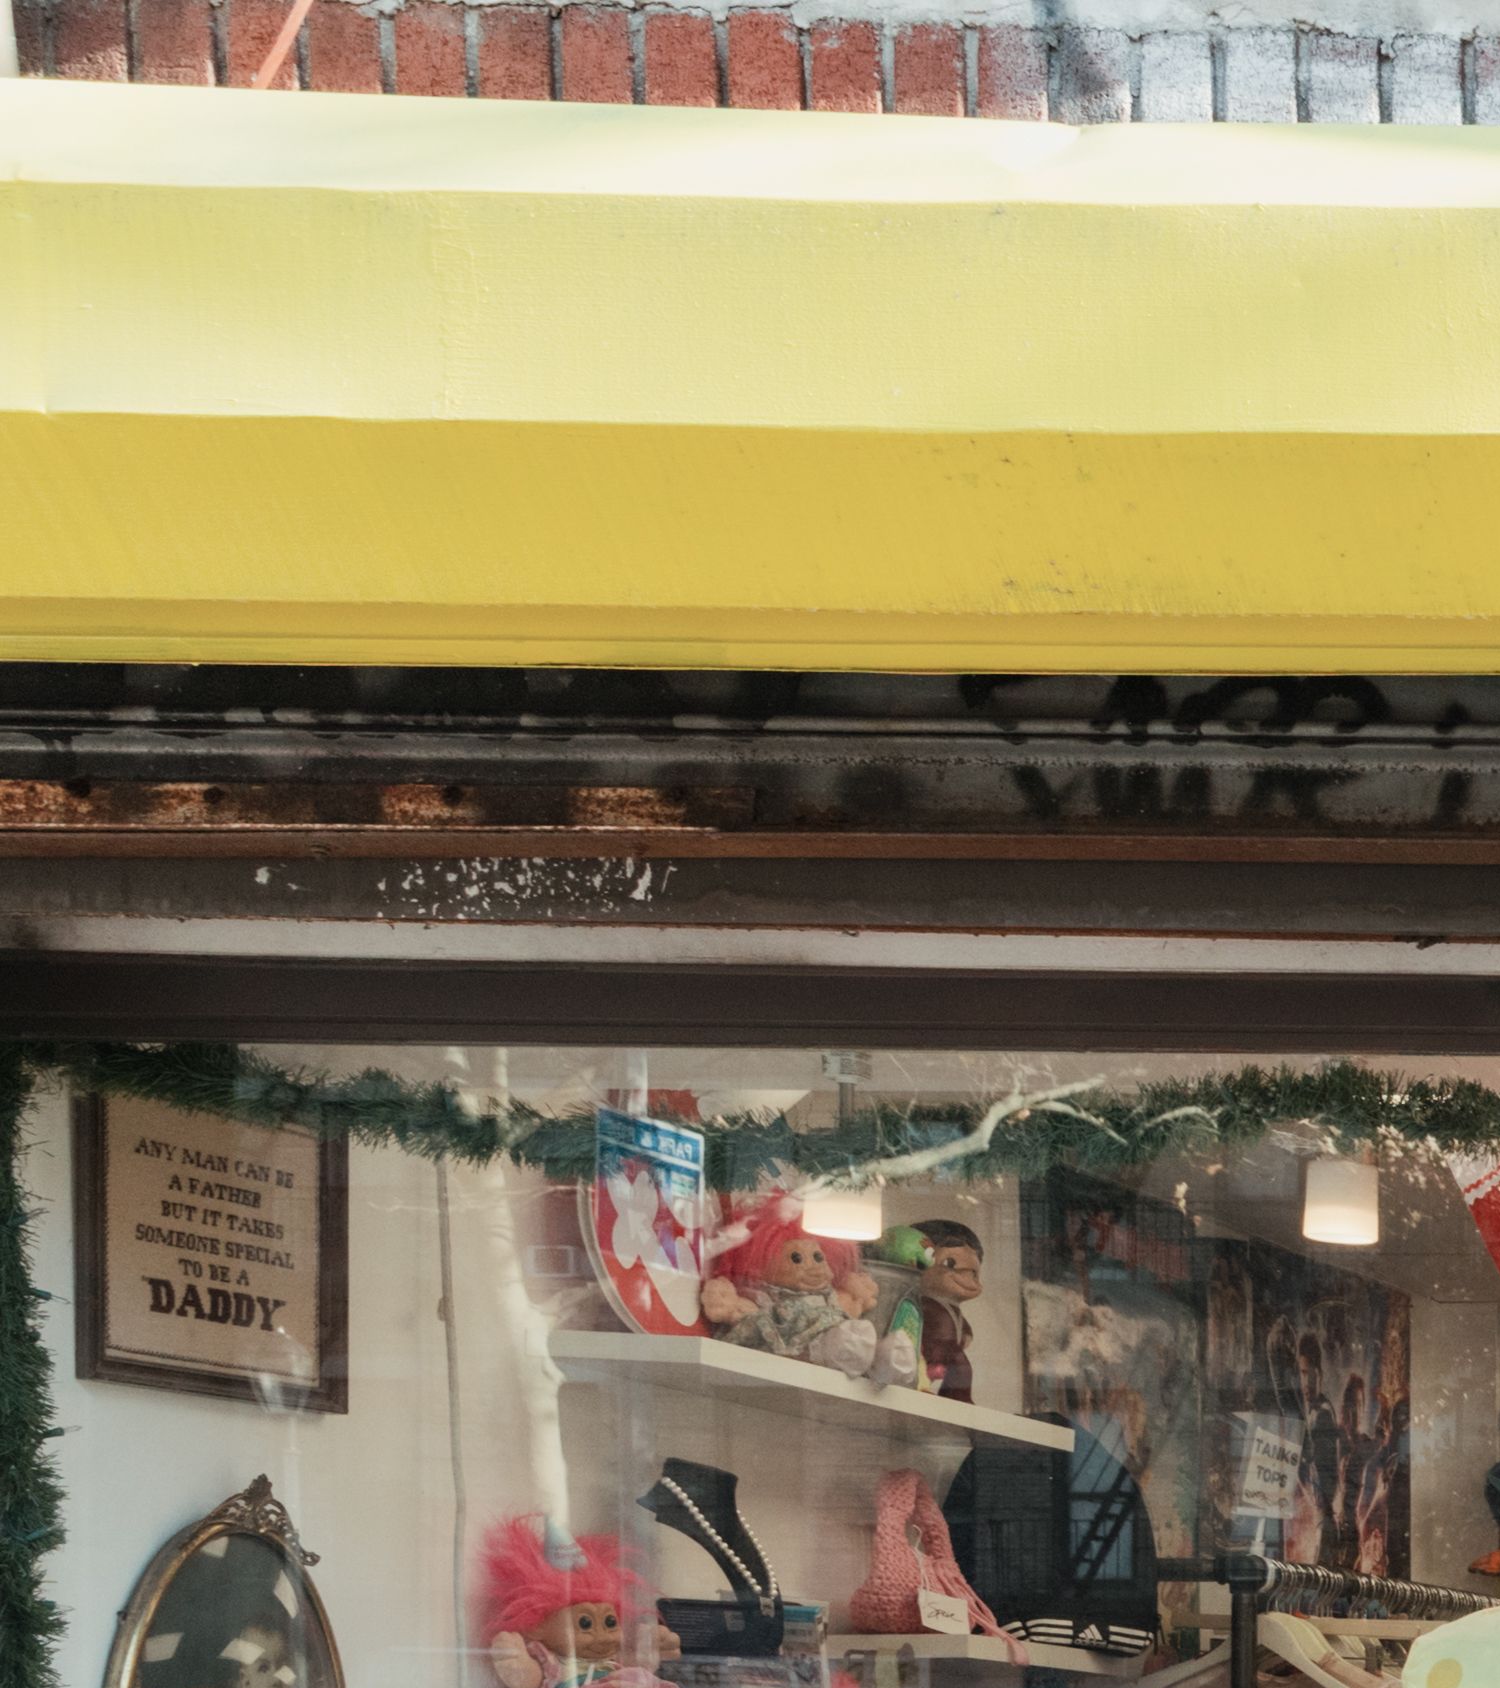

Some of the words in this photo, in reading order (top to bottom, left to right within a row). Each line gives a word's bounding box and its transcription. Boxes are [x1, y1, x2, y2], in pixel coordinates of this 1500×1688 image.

[134, 1137, 177, 1162] ANY
[182, 1148, 229, 1174] MAN
[234, 1159, 270, 1182] CAN
[275, 1169, 294, 1189] BE
[168, 1174, 182, 1191] A
[187, 1177, 262, 1209] FATHER
[161, 1200, 198, 1223] BUT
[201, 1208, 222, 1228] IT
[227, 1214, 284, 1240] TAKES
[135, 1223, 220, 1256] SOMEONE
[225, 1241, 295, 1270] SPECIAL
[178, 1258, 203, 1278] TO
[208, 1263, 230, 1283] BE
[236, 1269, 250, 1286] A
[146, 1276, 287, 1331] DADDY
[1256, 1438, 1299, 1467] TANKS
[1256, 1464, 1288, 1488] TOPS
